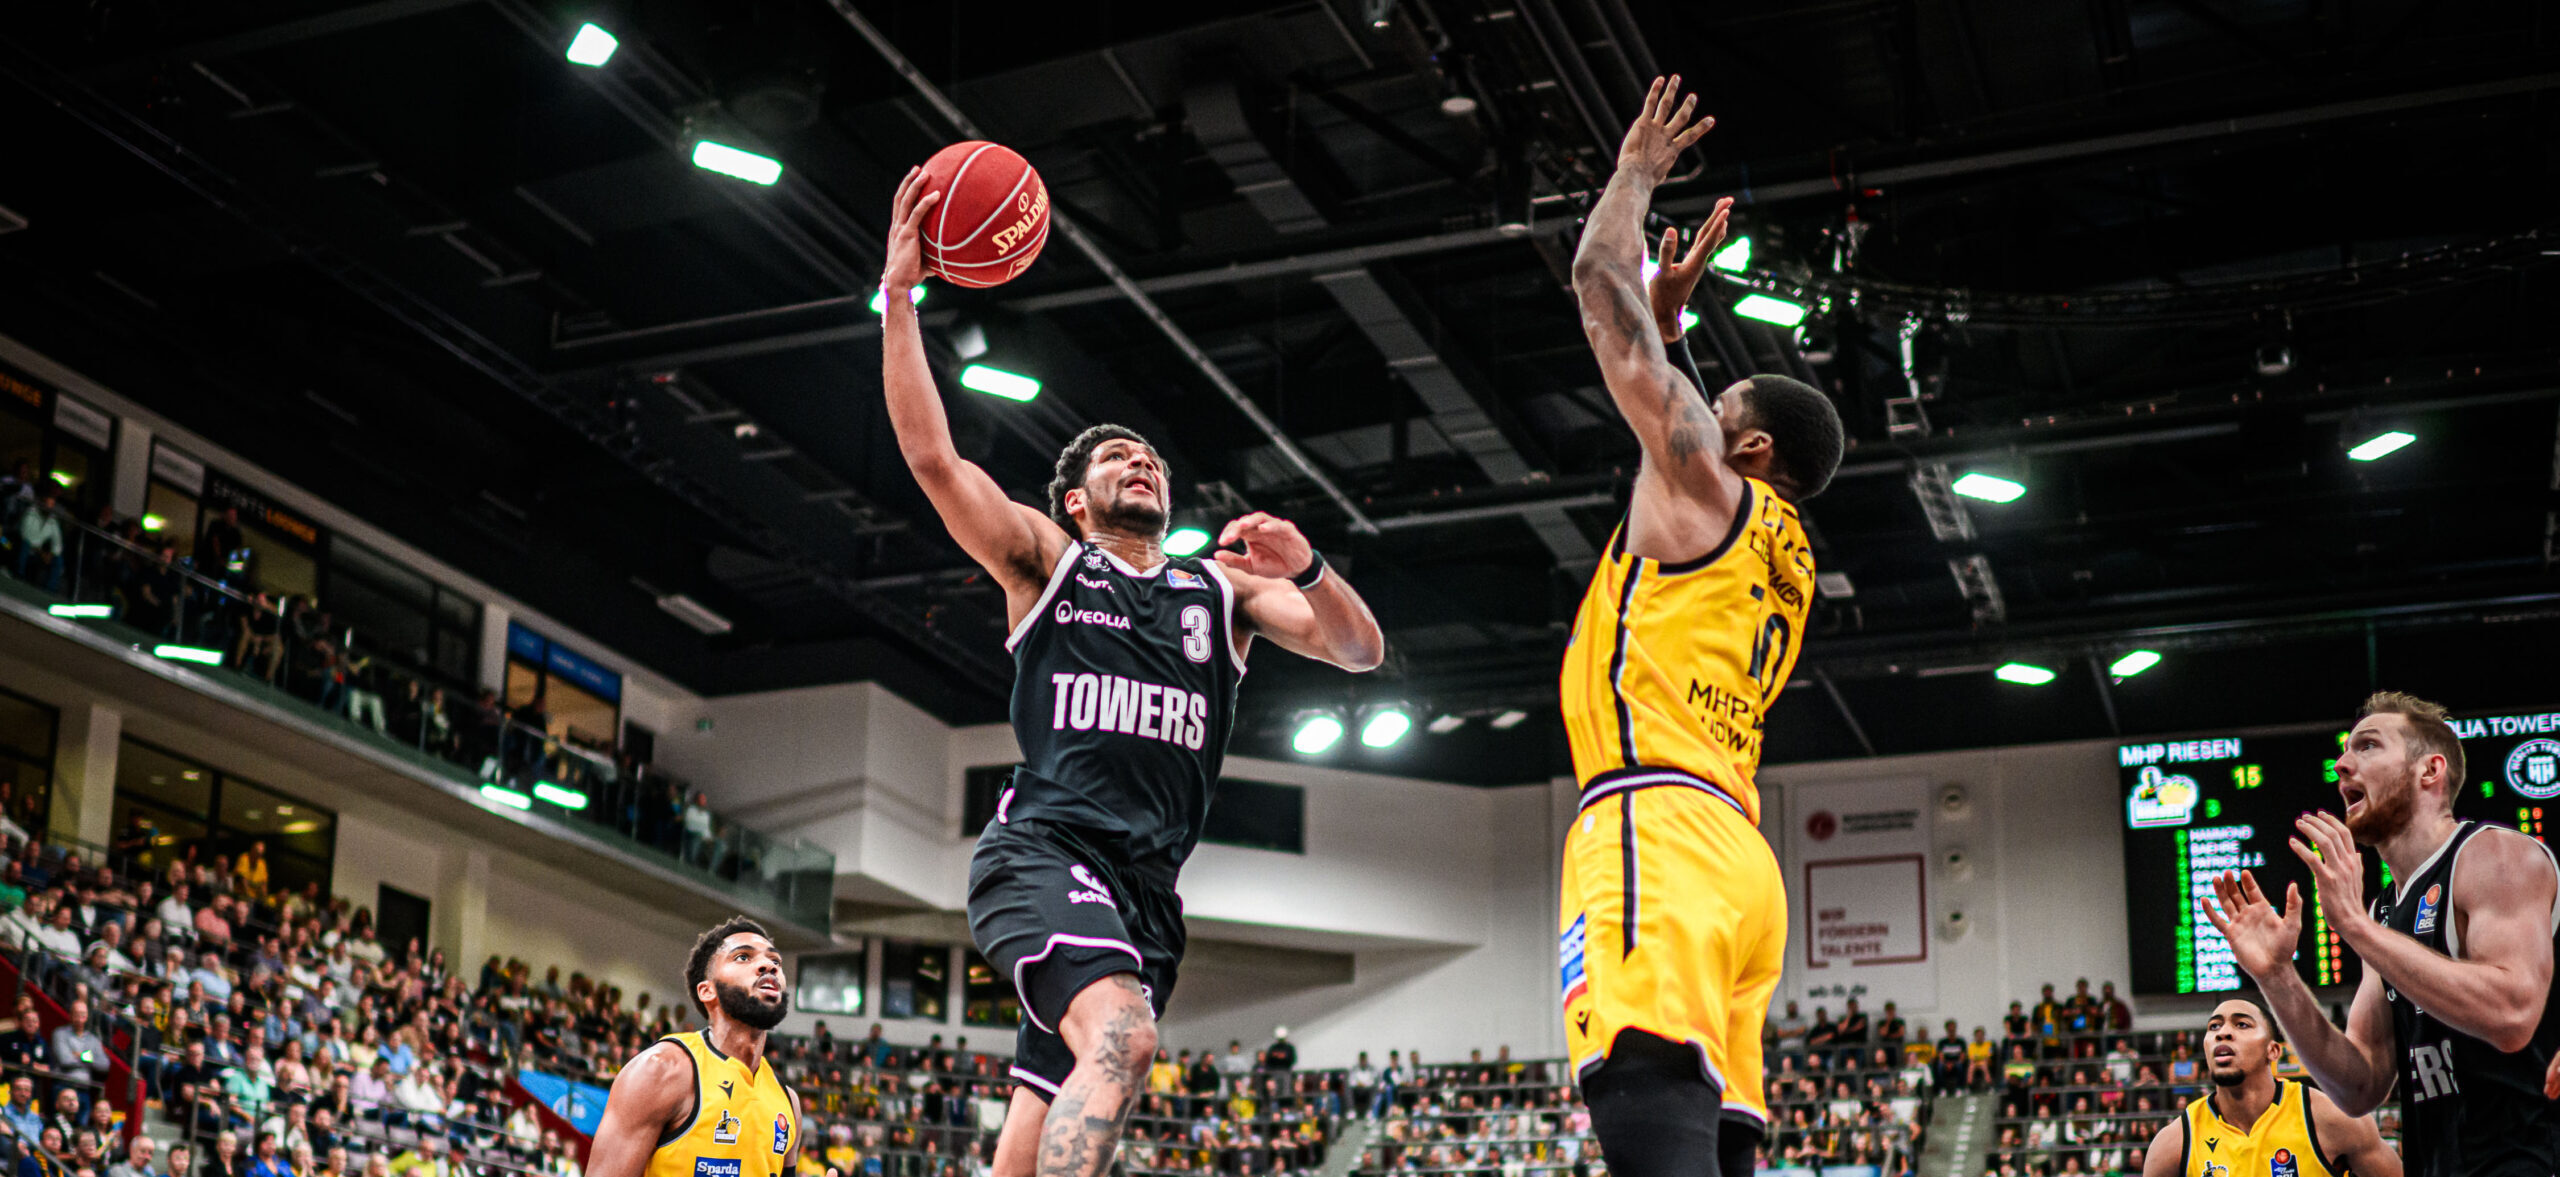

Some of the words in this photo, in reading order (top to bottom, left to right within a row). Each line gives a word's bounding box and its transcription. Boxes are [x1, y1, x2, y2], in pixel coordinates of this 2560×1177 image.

[992, 178, 1049, 256] SPALDIN
[1073, 609, 1131, 630] VEOLIA
[1181, 605, 1212, 664] 3
[1052, 673, 1208, 751] TOWERS
[1687, 678, 1749, 720] MHP
[2119, 745, 2165, 767] MHP
[2167, 738, 2241, 763] RIESEN
[2231, 764, 2263, 790] 15
[2191, 855, 2240, 869] PATRICK
[696, 1161, 739, 1176] Sparda
